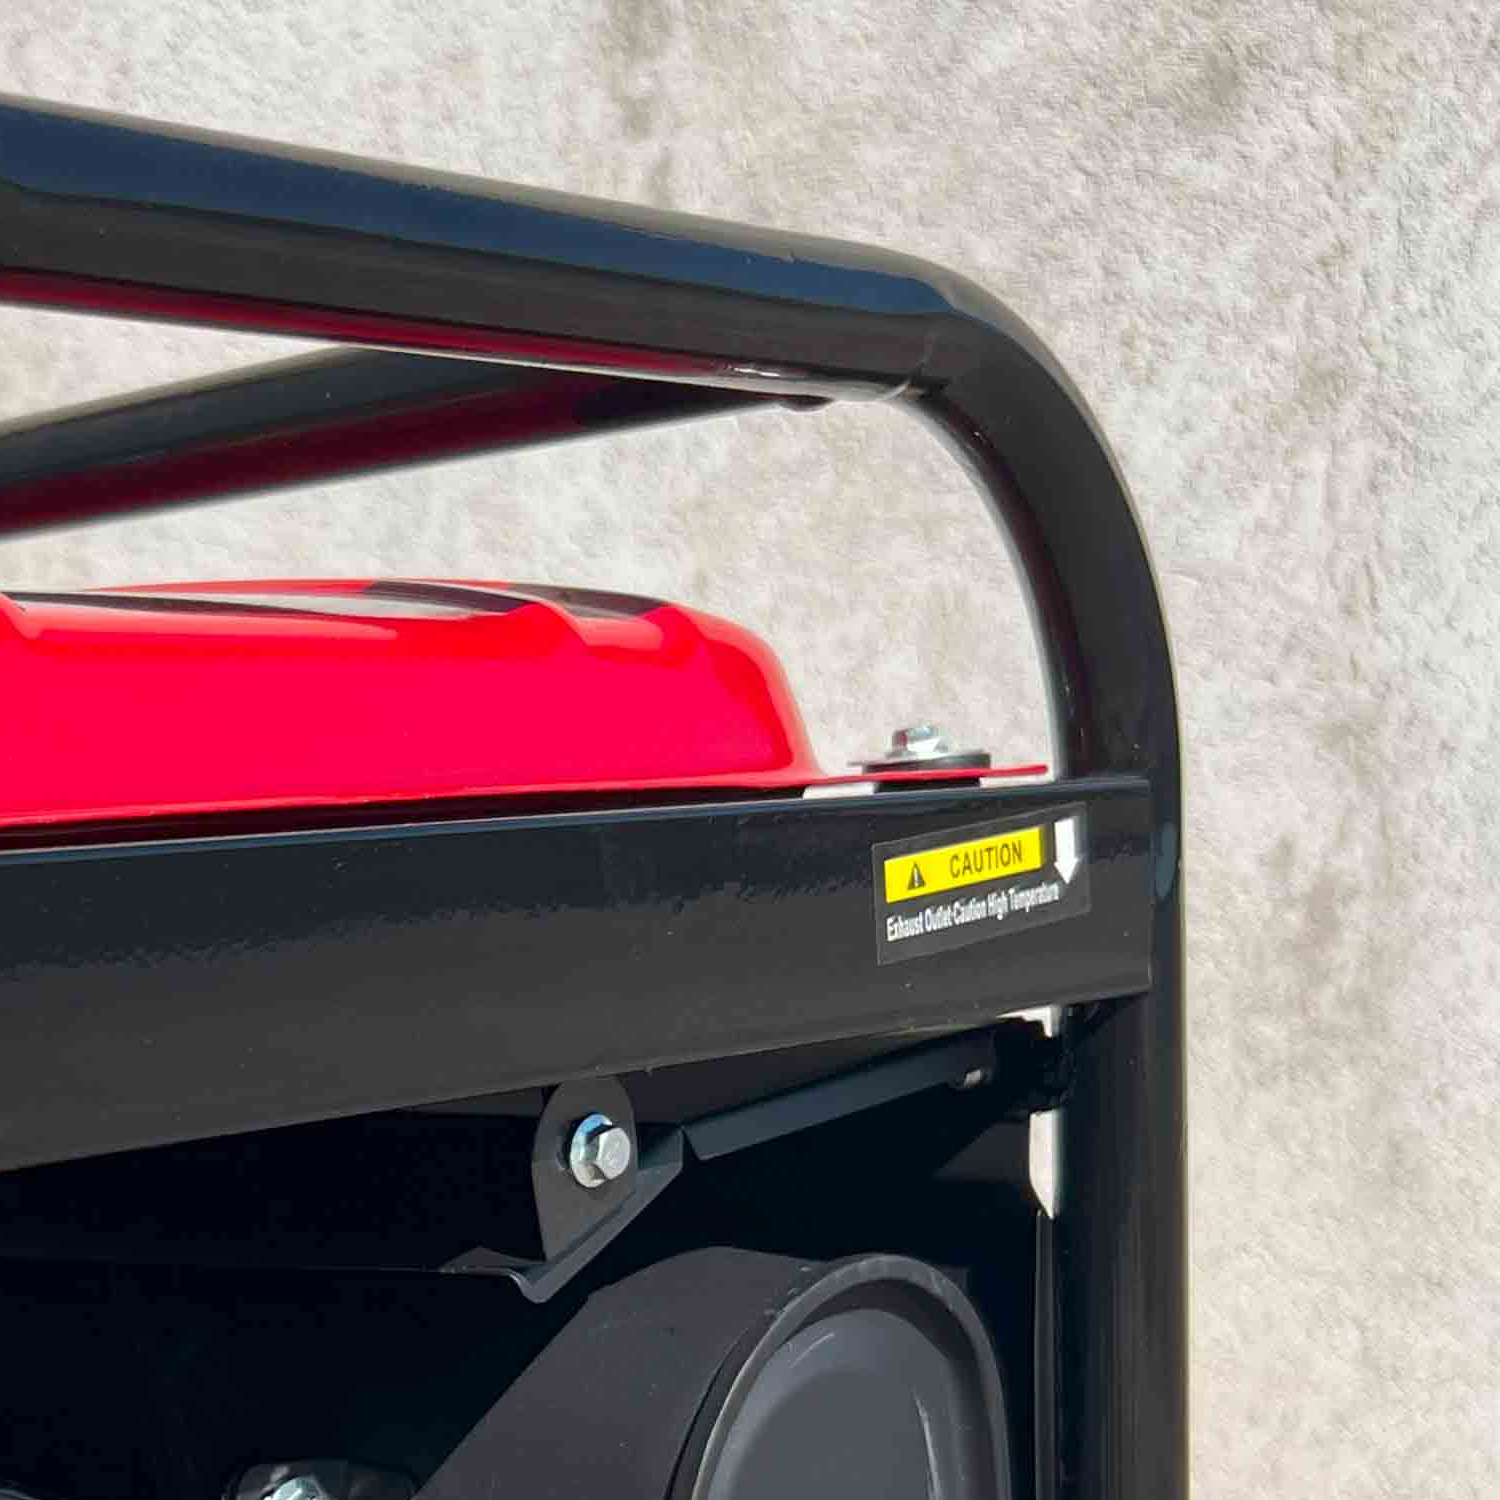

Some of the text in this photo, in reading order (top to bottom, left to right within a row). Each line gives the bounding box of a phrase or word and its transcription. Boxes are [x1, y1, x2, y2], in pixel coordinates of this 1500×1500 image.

[949, 839, 1023, 879] CAUTION
[886, 910, 924, 942] Exhaust
[988, 889, 1008, 920] High
